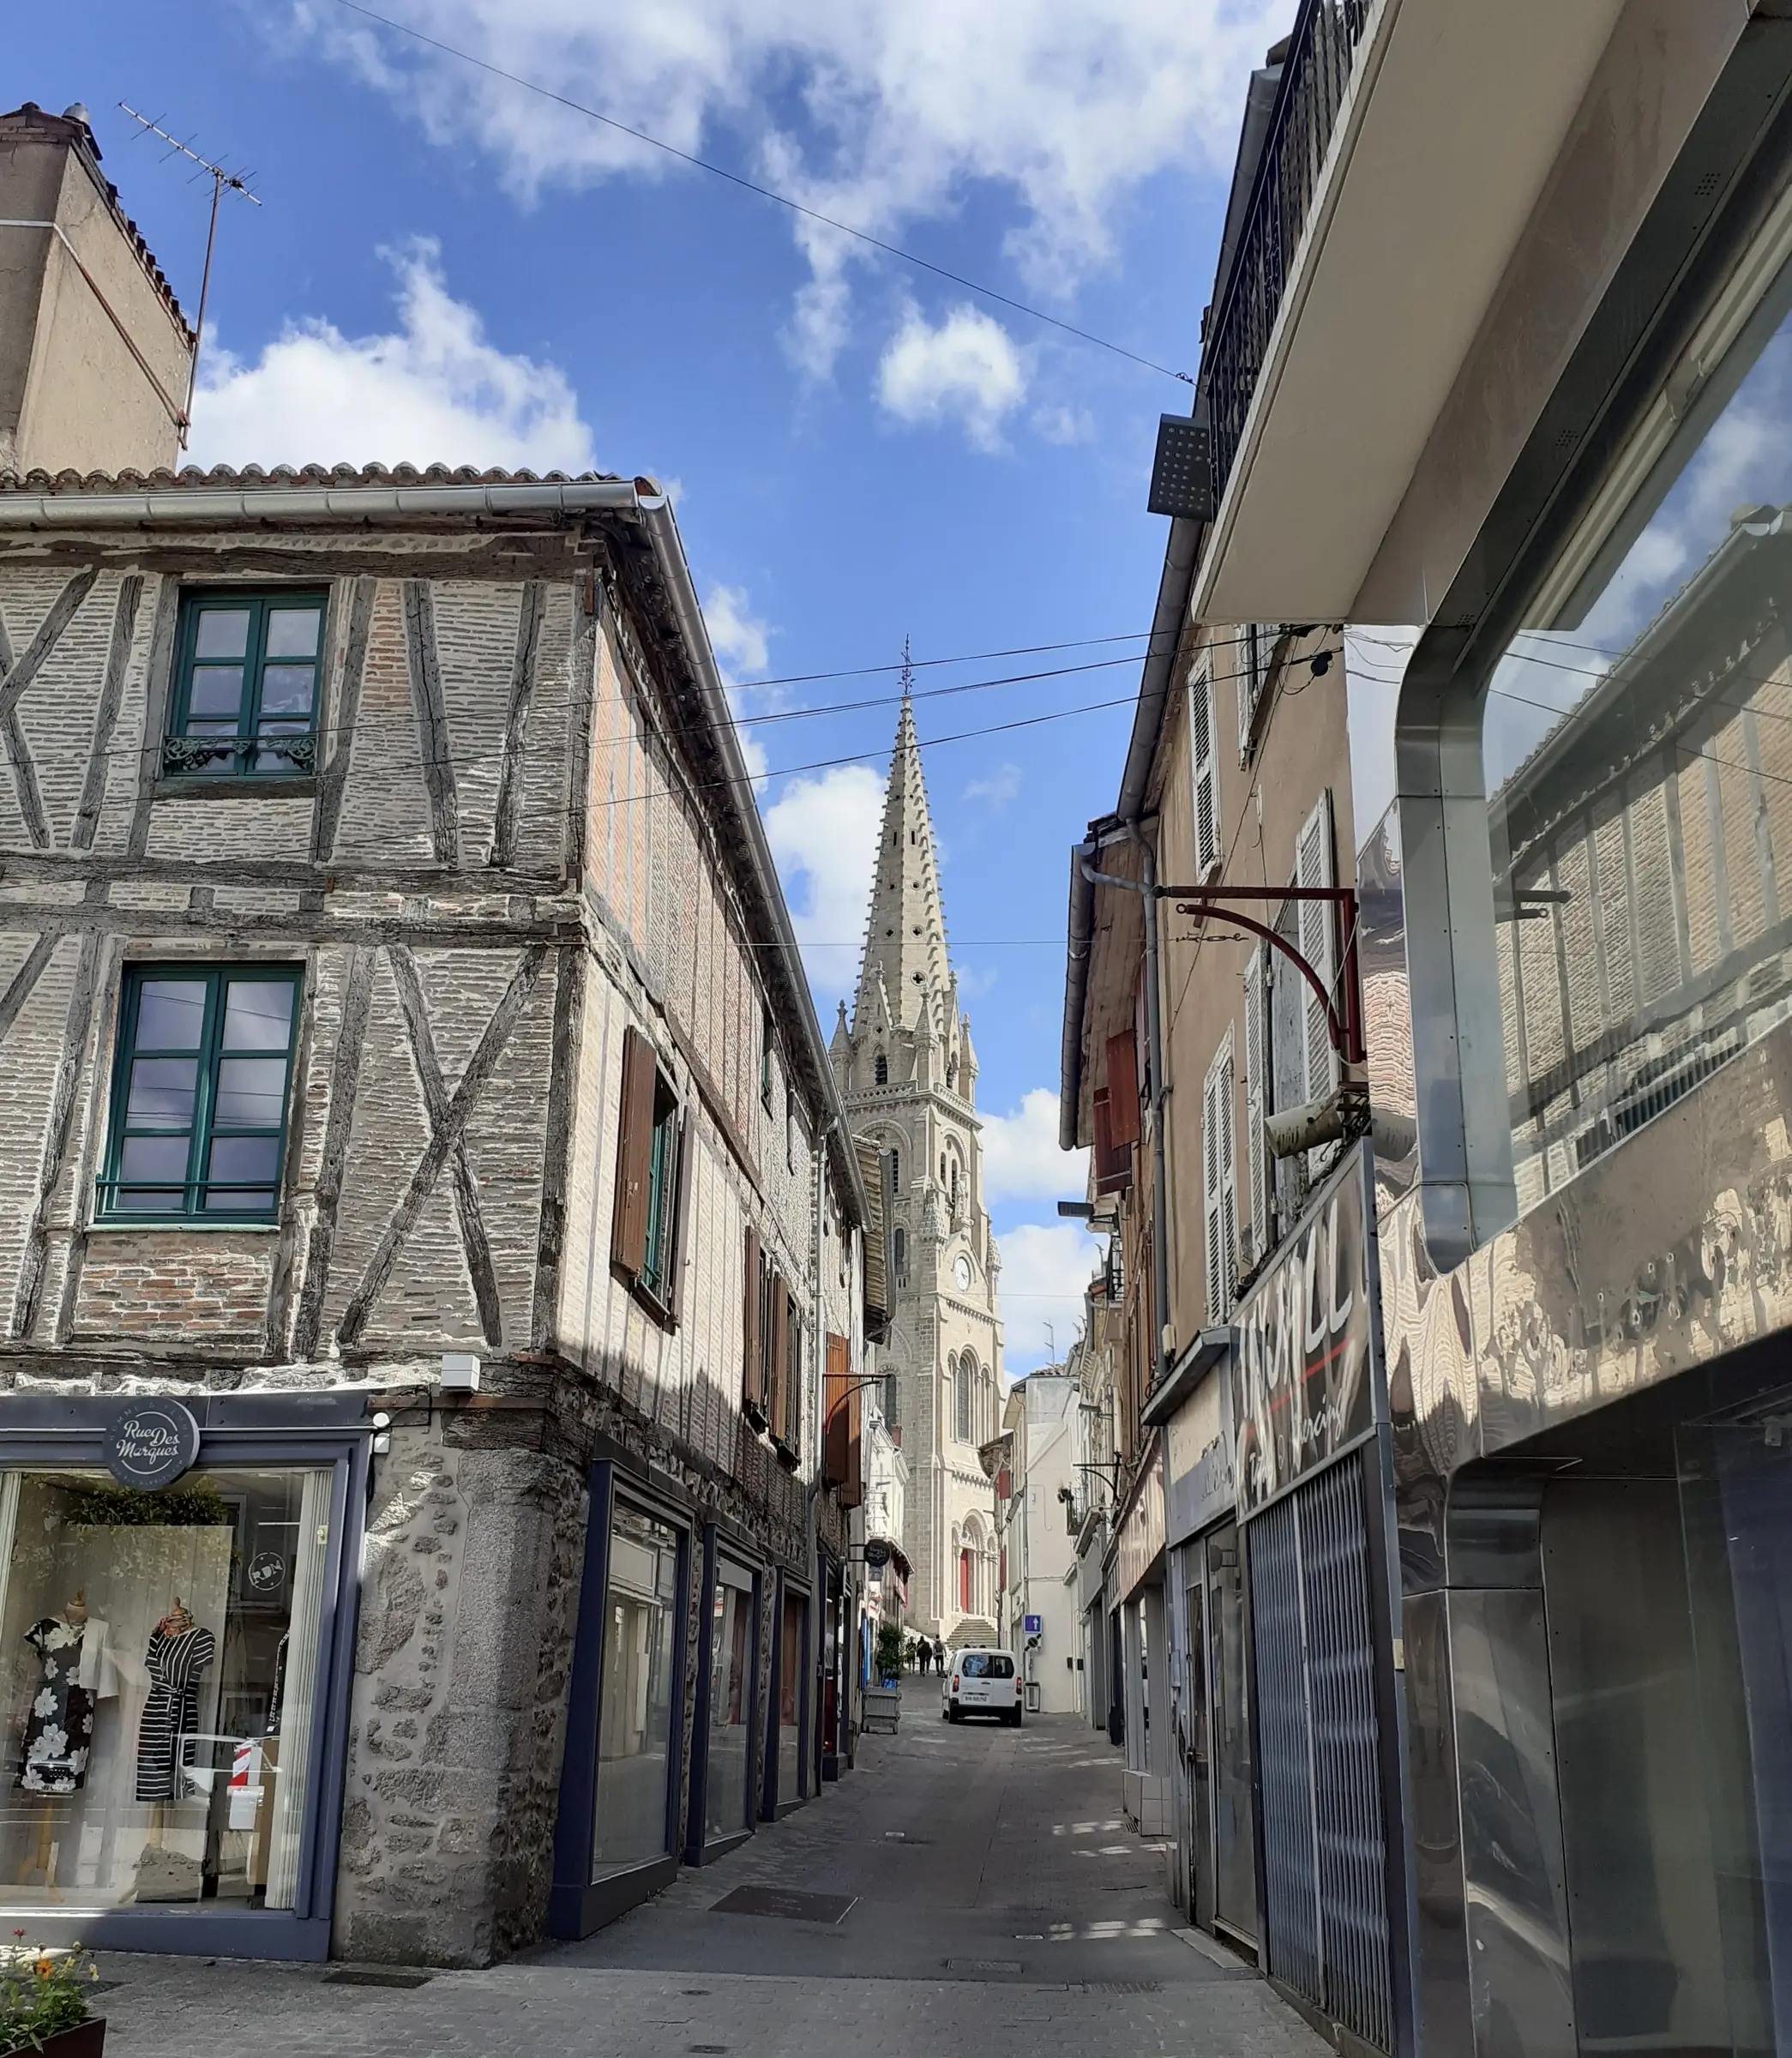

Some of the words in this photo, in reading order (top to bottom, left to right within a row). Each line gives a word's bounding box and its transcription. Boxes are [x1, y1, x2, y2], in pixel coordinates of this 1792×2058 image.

[123, 1420, 152, 1439] Rue
[149, 1427, 180, 1447] Des
[116, 1439, 179, 1465] Marques
[251, 1560, 283, 1585] RDM
